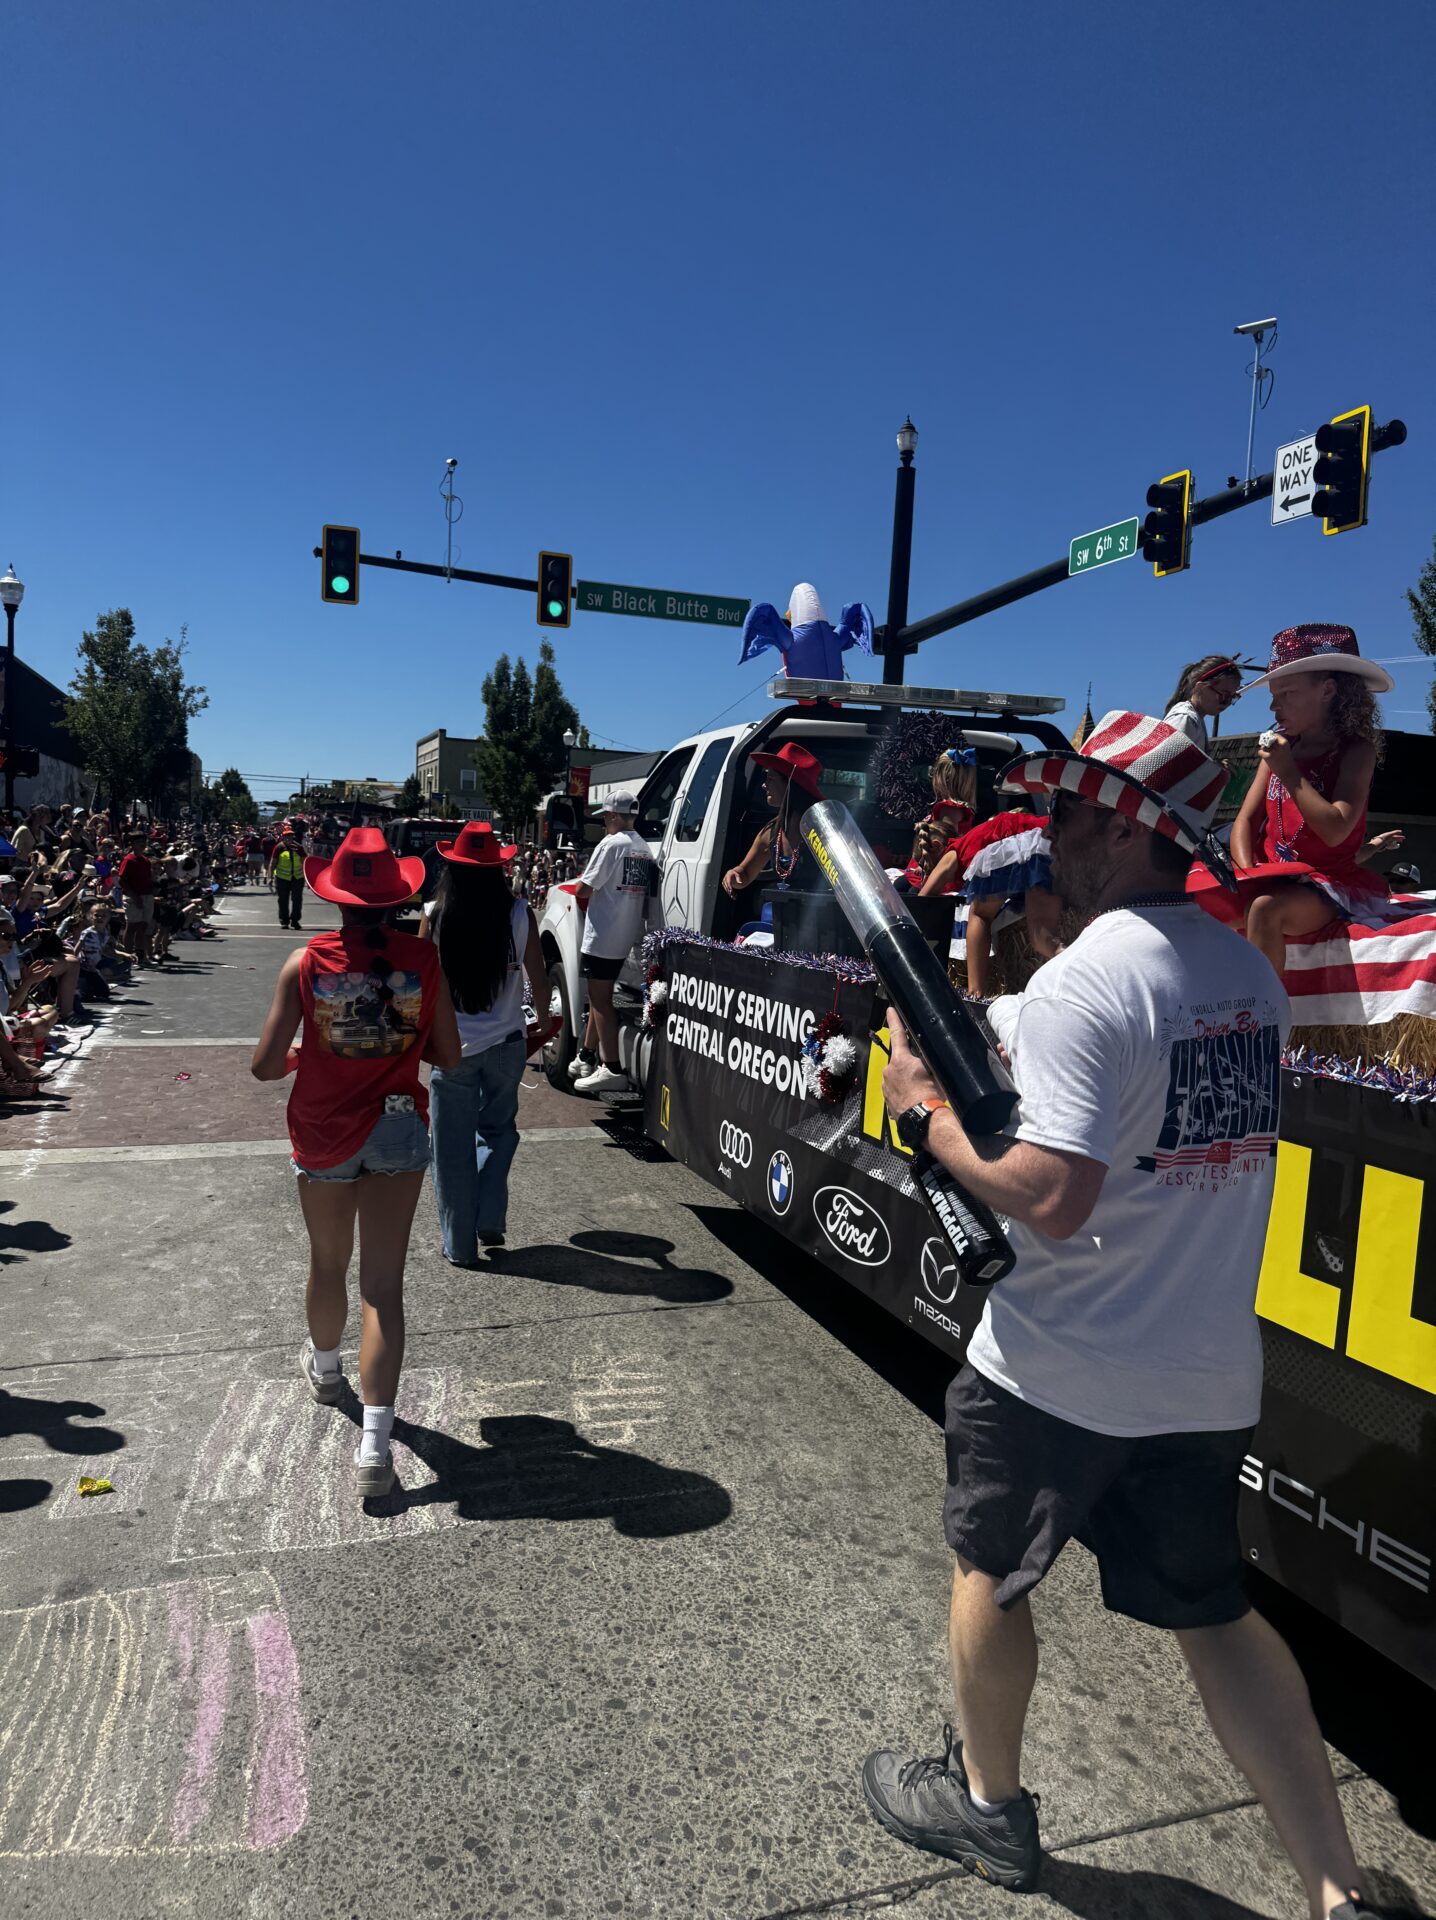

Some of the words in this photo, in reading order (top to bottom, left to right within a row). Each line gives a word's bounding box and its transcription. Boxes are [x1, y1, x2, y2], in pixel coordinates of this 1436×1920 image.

[1282, 445, 1313, 470] ONE
[1280, 467, 1312, 492] WAY
[1076, 548, 1089, 566] SW
[1095, 535, 1112, 560] 6th
[1118, 535, 1129, 552] St
[587, 592, 603, 606] SW
[612, 590, 656, 613] Black
[666, 597, 709, 618] Butte
[717, 608, 740, 622] Blvd
[808, 828, 838, 886] KENDALL
[669, 972, 735, 1019] PROUDLY
[735, 990, 819, 1045] SERVING
[1217, 999, 1231, 1011] AUTO
[1233, 996, 1256, 1010] GROUP
[1234, 1011, 1260, 1037] By
[667, 1013, 724, 1065] CENTRAL
[728, 1037, 807, 1101] OREGON
[718, 1161, 732, 1179] Audi
[826, 1193, 877, 1257] Ford
[1238, 1454, 1431, 1594] SCHE
